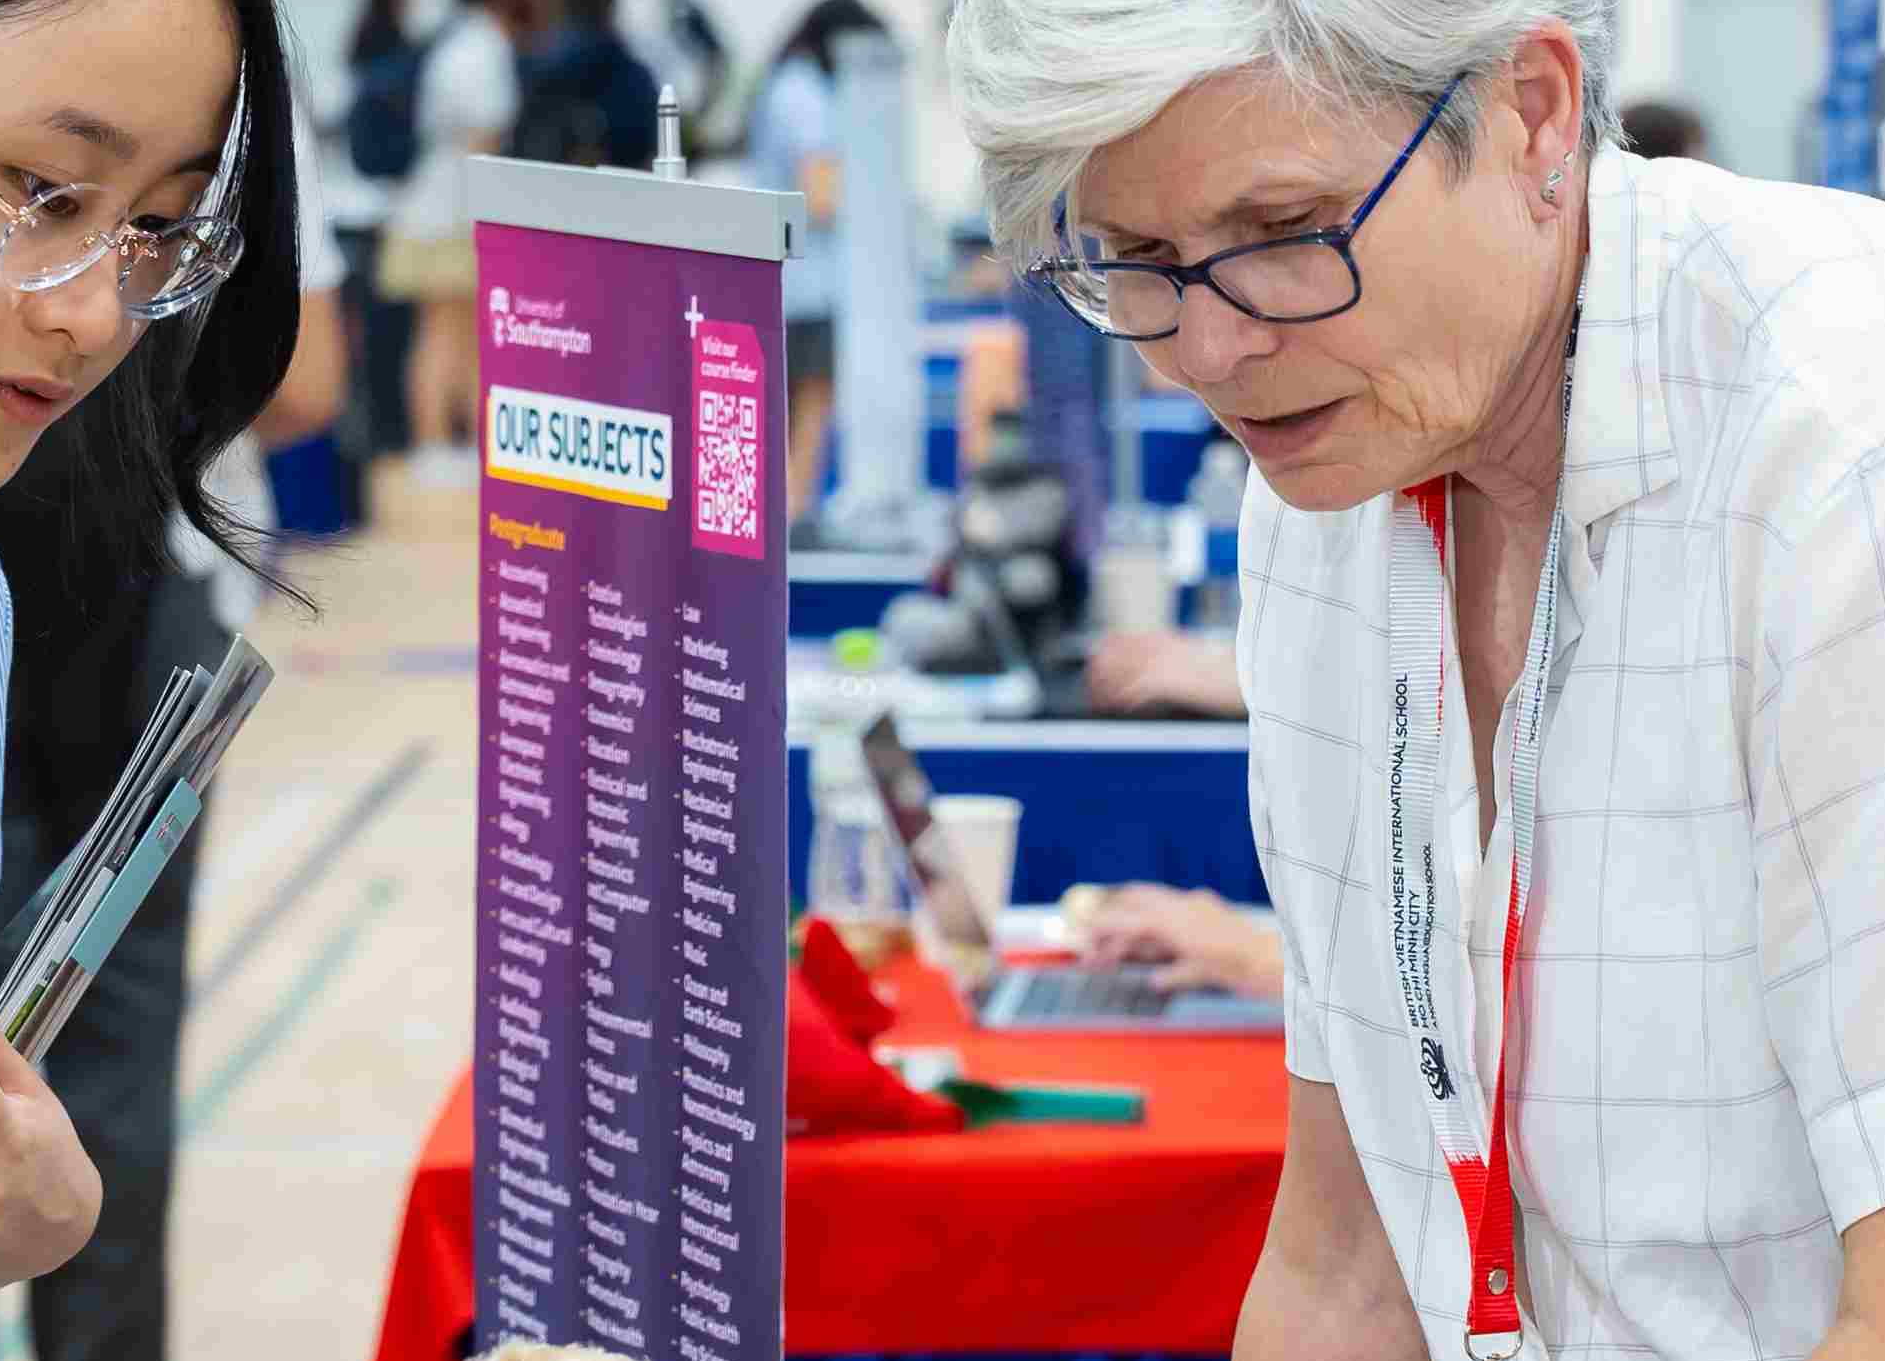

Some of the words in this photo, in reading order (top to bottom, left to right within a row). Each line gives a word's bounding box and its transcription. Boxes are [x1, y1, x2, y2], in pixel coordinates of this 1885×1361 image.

[507, 314, 592, 357] Southampton
[495, 403, 541, 455] OUR
[548, 411, 665, 481] SUBJECTS
[1395, 672, 1408, 738] SCHOOL
[1391, 740, 1406, 864] INTERNATIONAL
[1422, 843, 1434, 885] SCHOOL
[1393, 866, 1407, 967] VIETNAMESE
[1408, 890, 1421, 927] CITY
[1423, 885, 1435, 947] EDUCATION
[1408, 930, 1418, 973] MINH
[1400, 970, 1419, 1028] BRITISH
[1412, 975, 1424, 1002] CHI
[1418, 1006, 1429, 1028] HO
